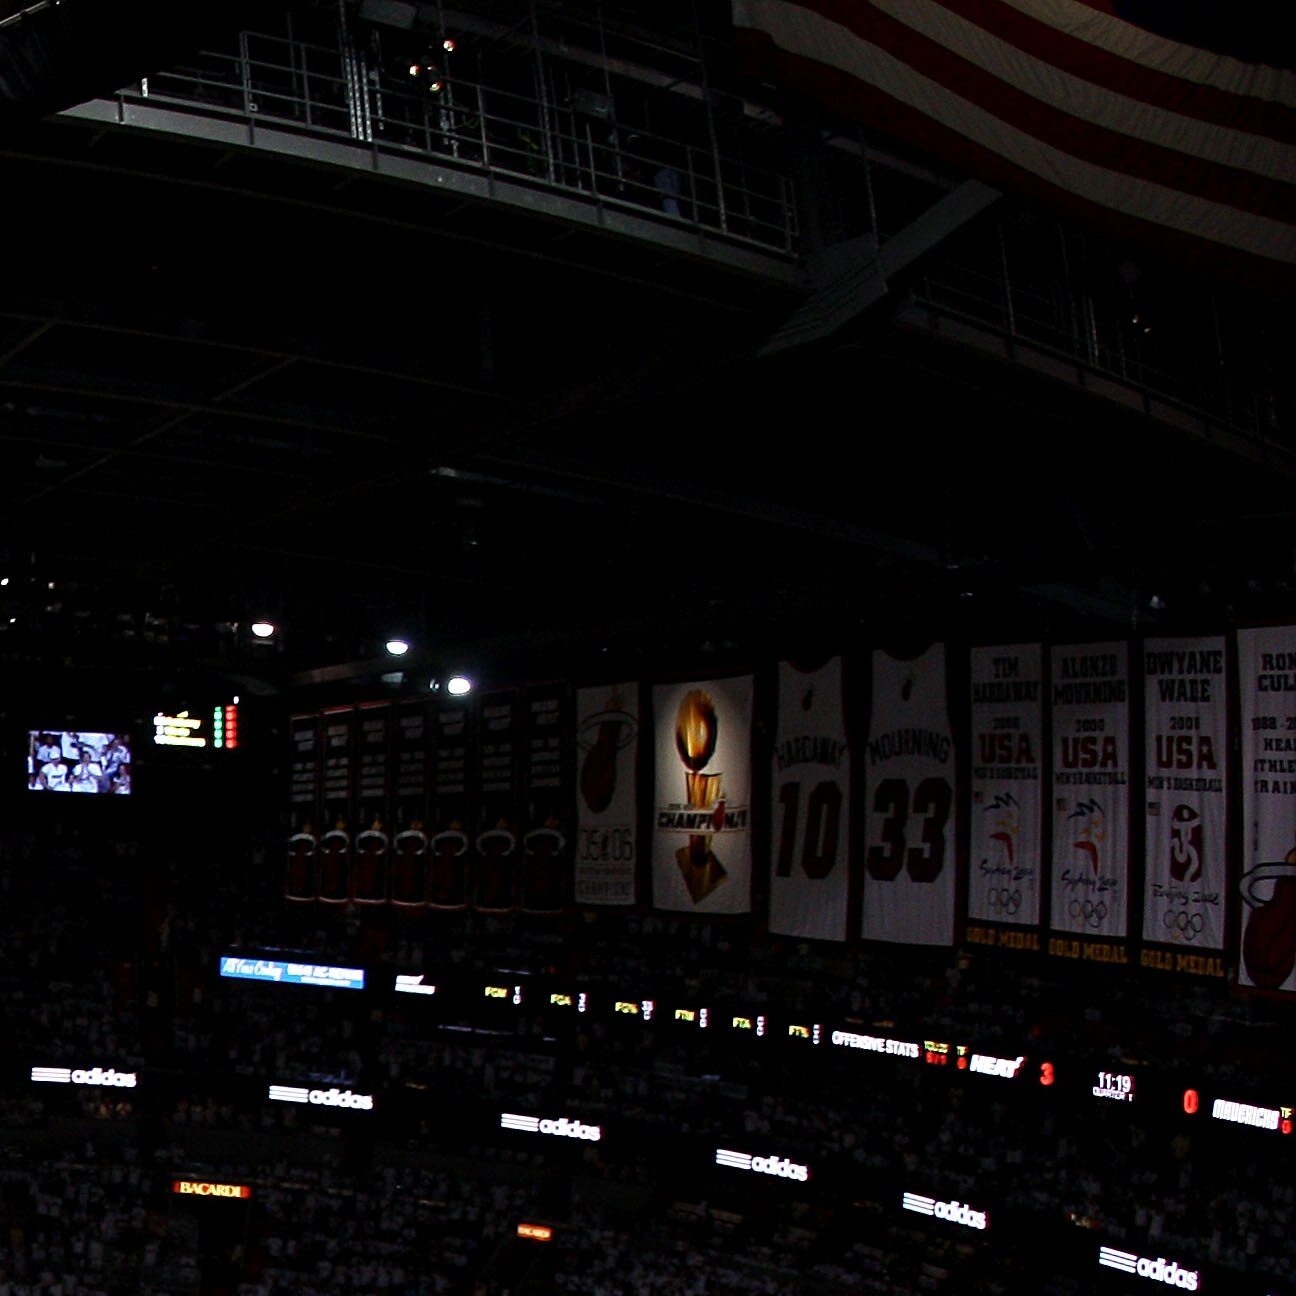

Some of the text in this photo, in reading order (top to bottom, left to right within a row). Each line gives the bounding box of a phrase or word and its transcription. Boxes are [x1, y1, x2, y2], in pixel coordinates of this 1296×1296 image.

[992, 657, 1019, 679] TIM
[1061, 654, 1118, 679] ALONZO
[1145, 650, 1223, 675] DWYANE
[1157, 678, 1211, 703] WADE
[869, 728, 951, 766] MOURNING
[979, 733, 1035, 765] USA
[1061, 735, 1119, 769] USA
[1155, 734, 1217, 770] USA
[777, 781, 842, 879] 10
[868, 777, 952, 883] 33
[965, 926, 1040, 950] GOLD MEDAL
[1049, 938, 1128, 964] GOLD MEDAL
[1140, 948, 1224, 977] GOLD MEDAL
[71, 1067, 137, 1088] adidas
[831, 1030, 886, 1053] OFFENSIVE
[886, 1039, 920, 1058] STATS
[969, 1053, 1024, 1079] HEAT
[1039, 1061, 1055, 1086] 3
[1097, 1072, 1131, 1094] 11:19
[1183, 1088, 1199, 1115] 0
[1212, 1098, 1280, 1131] MAVERICKS
[308, 1088, 373, 1110] adidas
[539, 1117, 602, 1142] adidas
[750, 1155, 808, 1182] adidas
[179, 1181, 242, 1198] BACARDI
[934, 1200, 987, 1230] adidas
[1137, 1257, 1199, 1291] adidas
